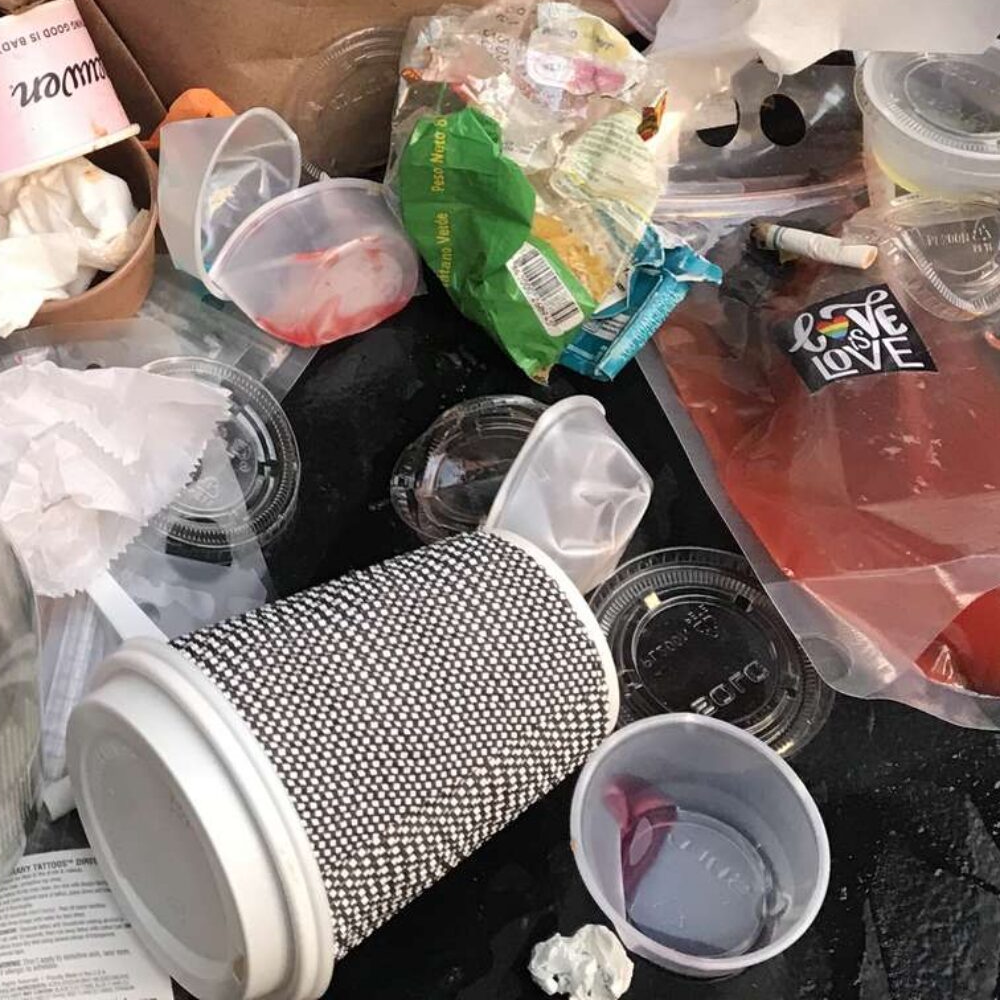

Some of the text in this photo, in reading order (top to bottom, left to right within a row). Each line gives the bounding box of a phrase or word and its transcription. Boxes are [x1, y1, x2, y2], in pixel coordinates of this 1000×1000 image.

[30, 33, 41, 43] IS
[44, 23, 70, 38] GOOD
[811, 336, 925, 381] LOVE
